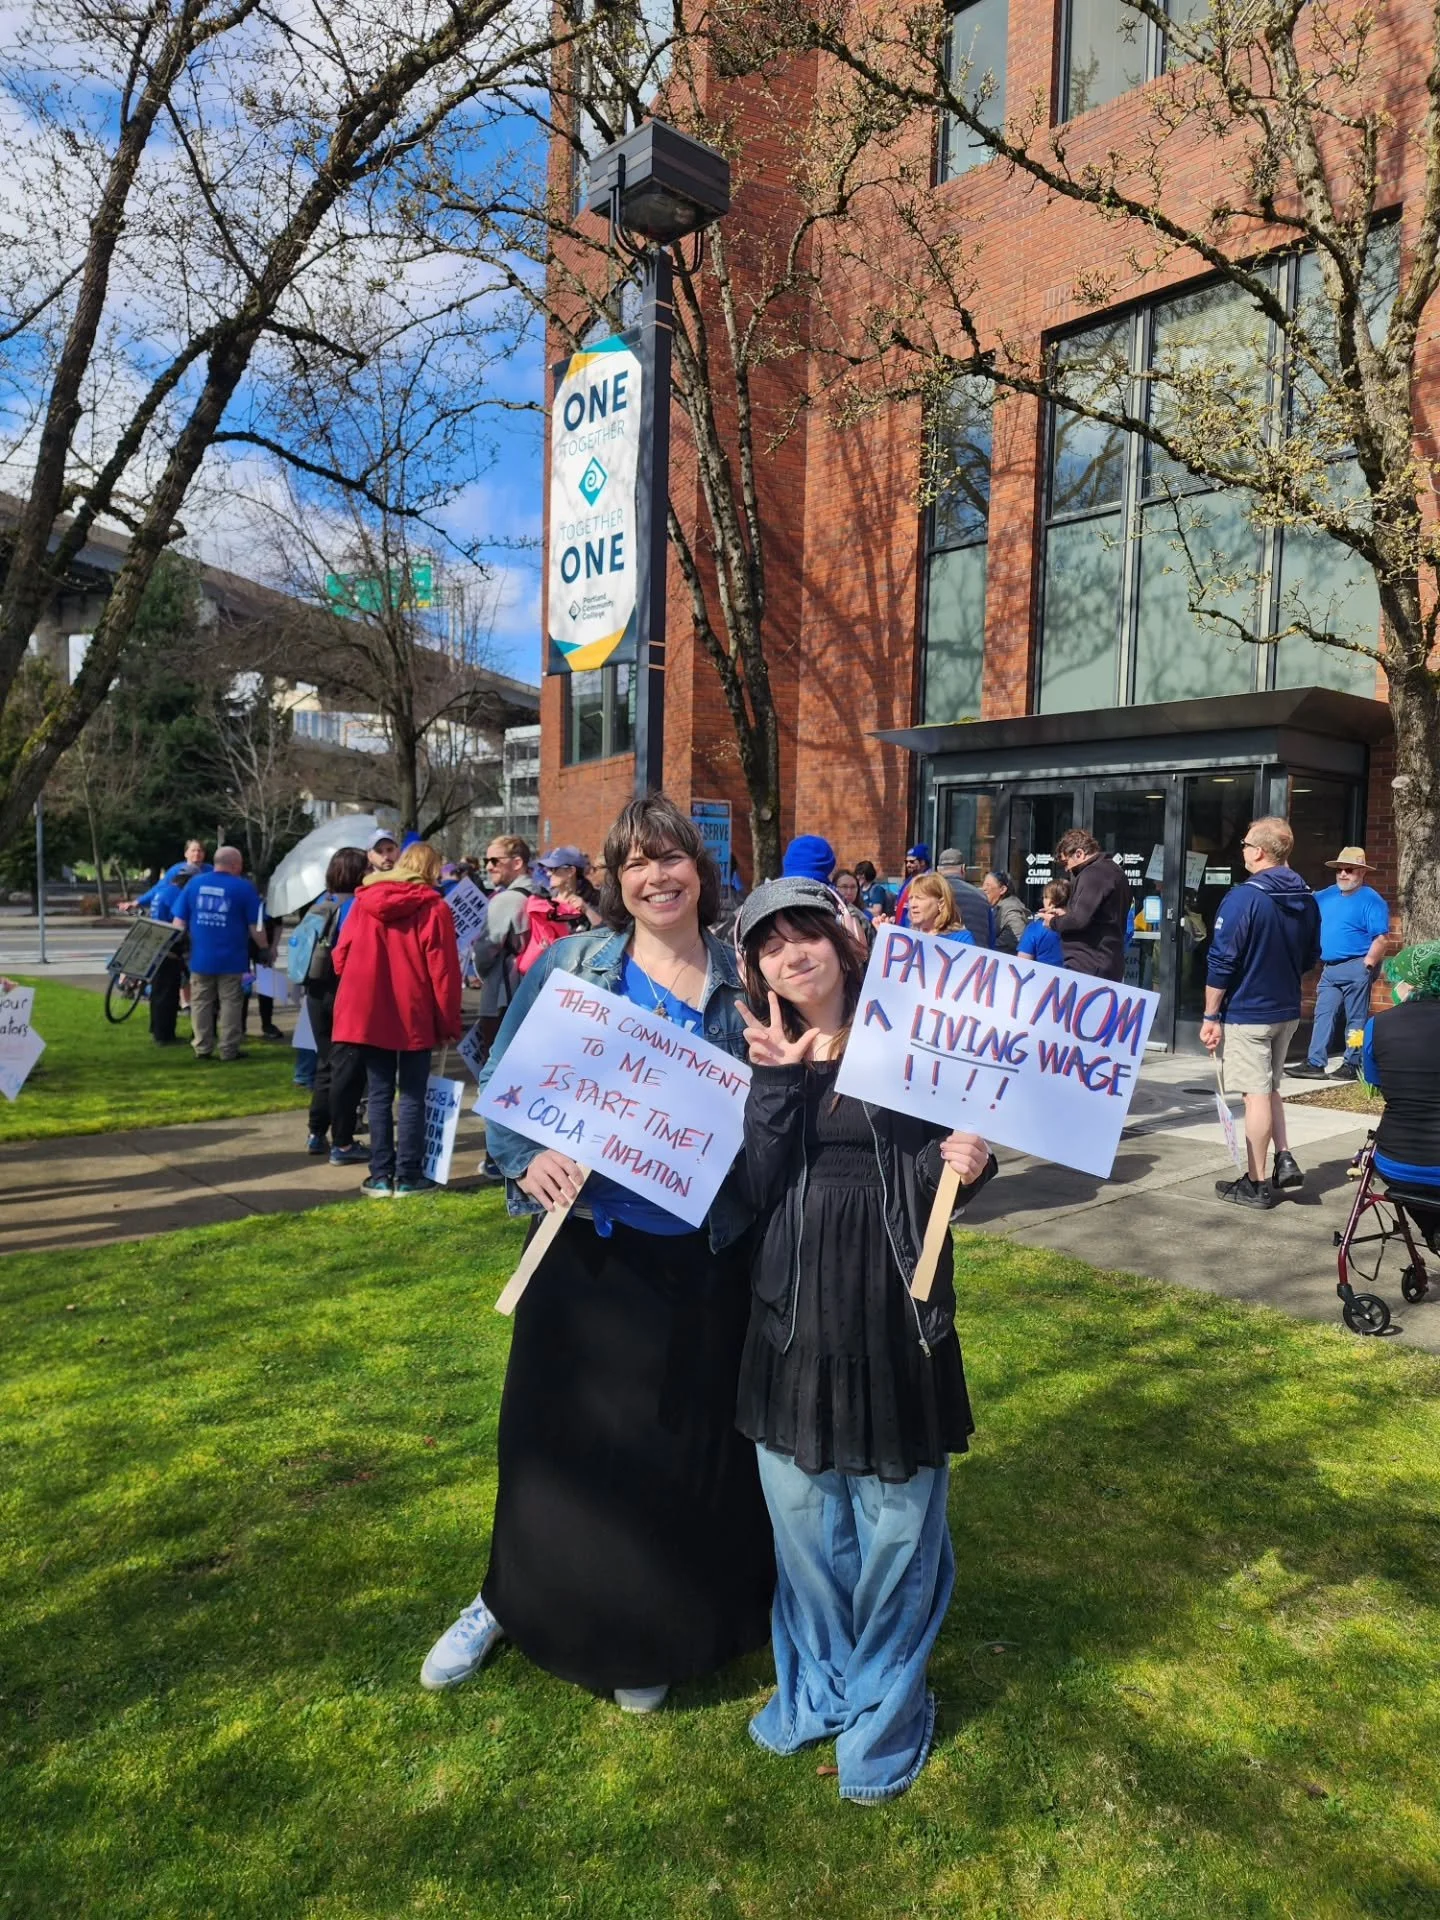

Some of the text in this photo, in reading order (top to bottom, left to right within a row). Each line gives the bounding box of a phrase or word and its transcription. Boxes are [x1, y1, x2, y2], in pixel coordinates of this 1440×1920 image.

[563, 369, 628, 432] ONE
[558, 419, 625, 459] TOGETHER
[560, 507, 624, 541] TOGETHER
[560, 531, 625, 584] ONE
[1027, 868, 1051, 877] CLIMB
[452, 893, 482, 928] WORTH
[470, 895, 485, 912] AM
[881, 932, 1147, 1057] PAY MY MOM
[554, 987, 612, 1026] THEIR
[617, 1016, 750, 1097] COMMITMENT
[581, 1037, 668, 1087] TO ME
[909, 1003, 1029, 1065] LIVING
[1038, 1039, 1132, 1097] WAGE
[539, 1063, 576, 1091] IS
[527, 1097, 585, 1144] COLA
[601, 1134, 694, 1198] INFLATION
